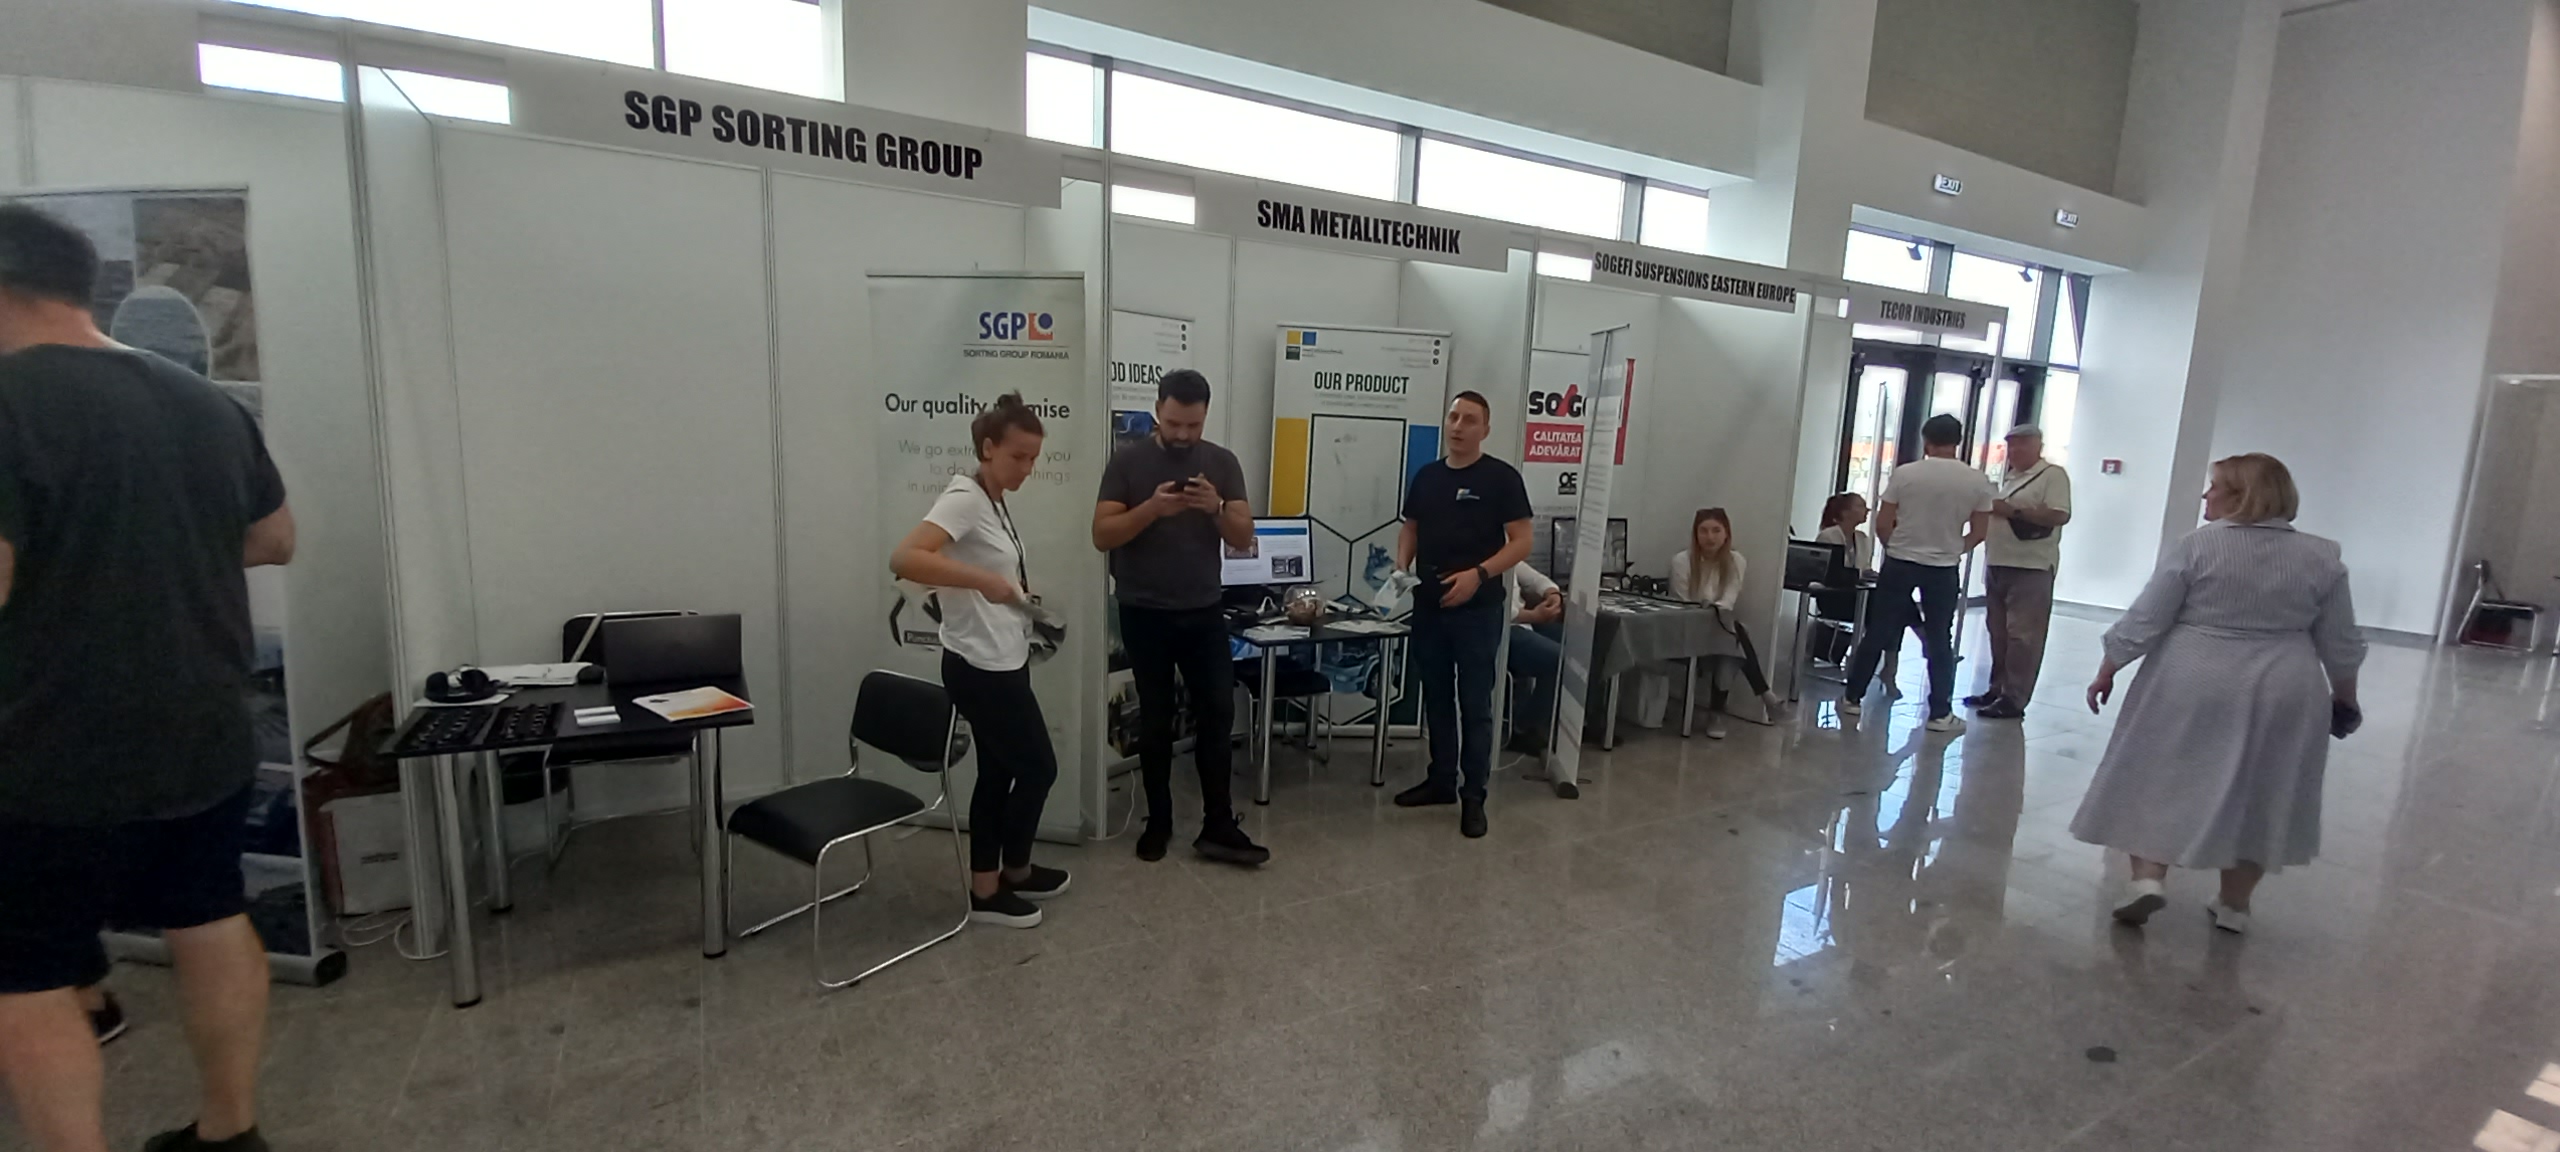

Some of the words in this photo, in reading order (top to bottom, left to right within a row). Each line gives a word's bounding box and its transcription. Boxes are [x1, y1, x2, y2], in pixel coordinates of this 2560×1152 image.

[624, 90, 702, 137] SGP
[712, 104, 867, 164] SORTING
[876, 132, 983, 180] GROUP
[1941, 176, 1960, 193] EXIT
[1257, 199, 1306, 234] SMA
[1310, 207, 1461, 255] METALLTECHNIK
[1594, 251, 1633, 277] SOGEFI
[1635, 260, 1709, 290] SUSPENSIONS
[1711, 274, 1755, 298] EASTERN
[1756, 282, 1796, 304] EUROPE
[979, 311, 1027, 341] SGP
[1880, 300, 1912, 322] TECOR
[1912, 304, 1966, 330] INDUSTRIES
[999, 350, 1029, 359] GROUP
[1128, 362, 1163, 386] IDEAS
[1313, 371, 1342, 391] OUR
[1345, 373, 1410, 395] PRODUCT
[885, 392, 918, 413] Our
[922, 392, 988, 419] quality
[1533, 430, 1582, 444] CALITATEA
[898, 439, 921, 455] We
[924, 444, 943, 458] go
[1045, 450, 1071, 465] you
